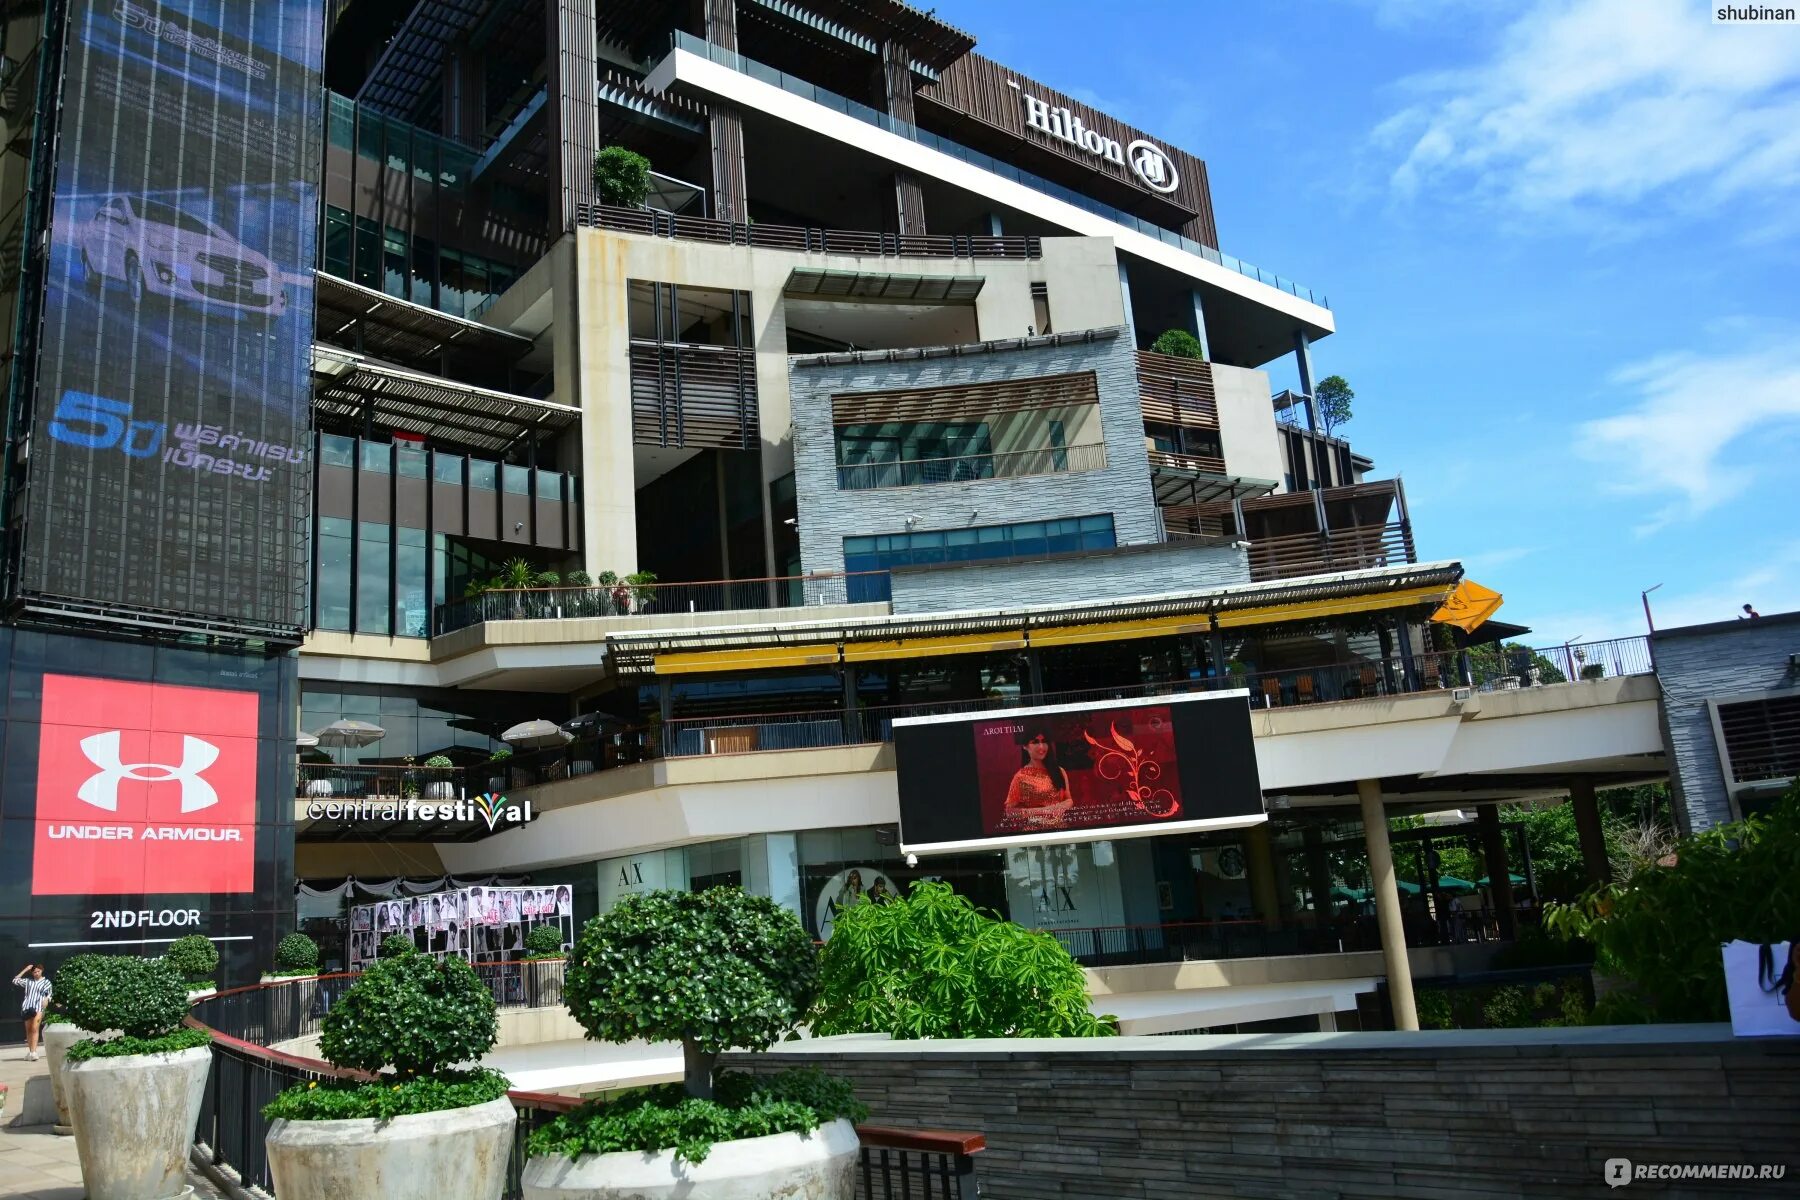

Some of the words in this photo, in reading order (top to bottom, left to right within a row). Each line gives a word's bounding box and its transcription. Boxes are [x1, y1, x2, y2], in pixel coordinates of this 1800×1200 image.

[1024, 94, 1126, 167] Hilton
[48, 825, 134, 840] UNDER
[141, 827, 241, 842] ARMOUR
